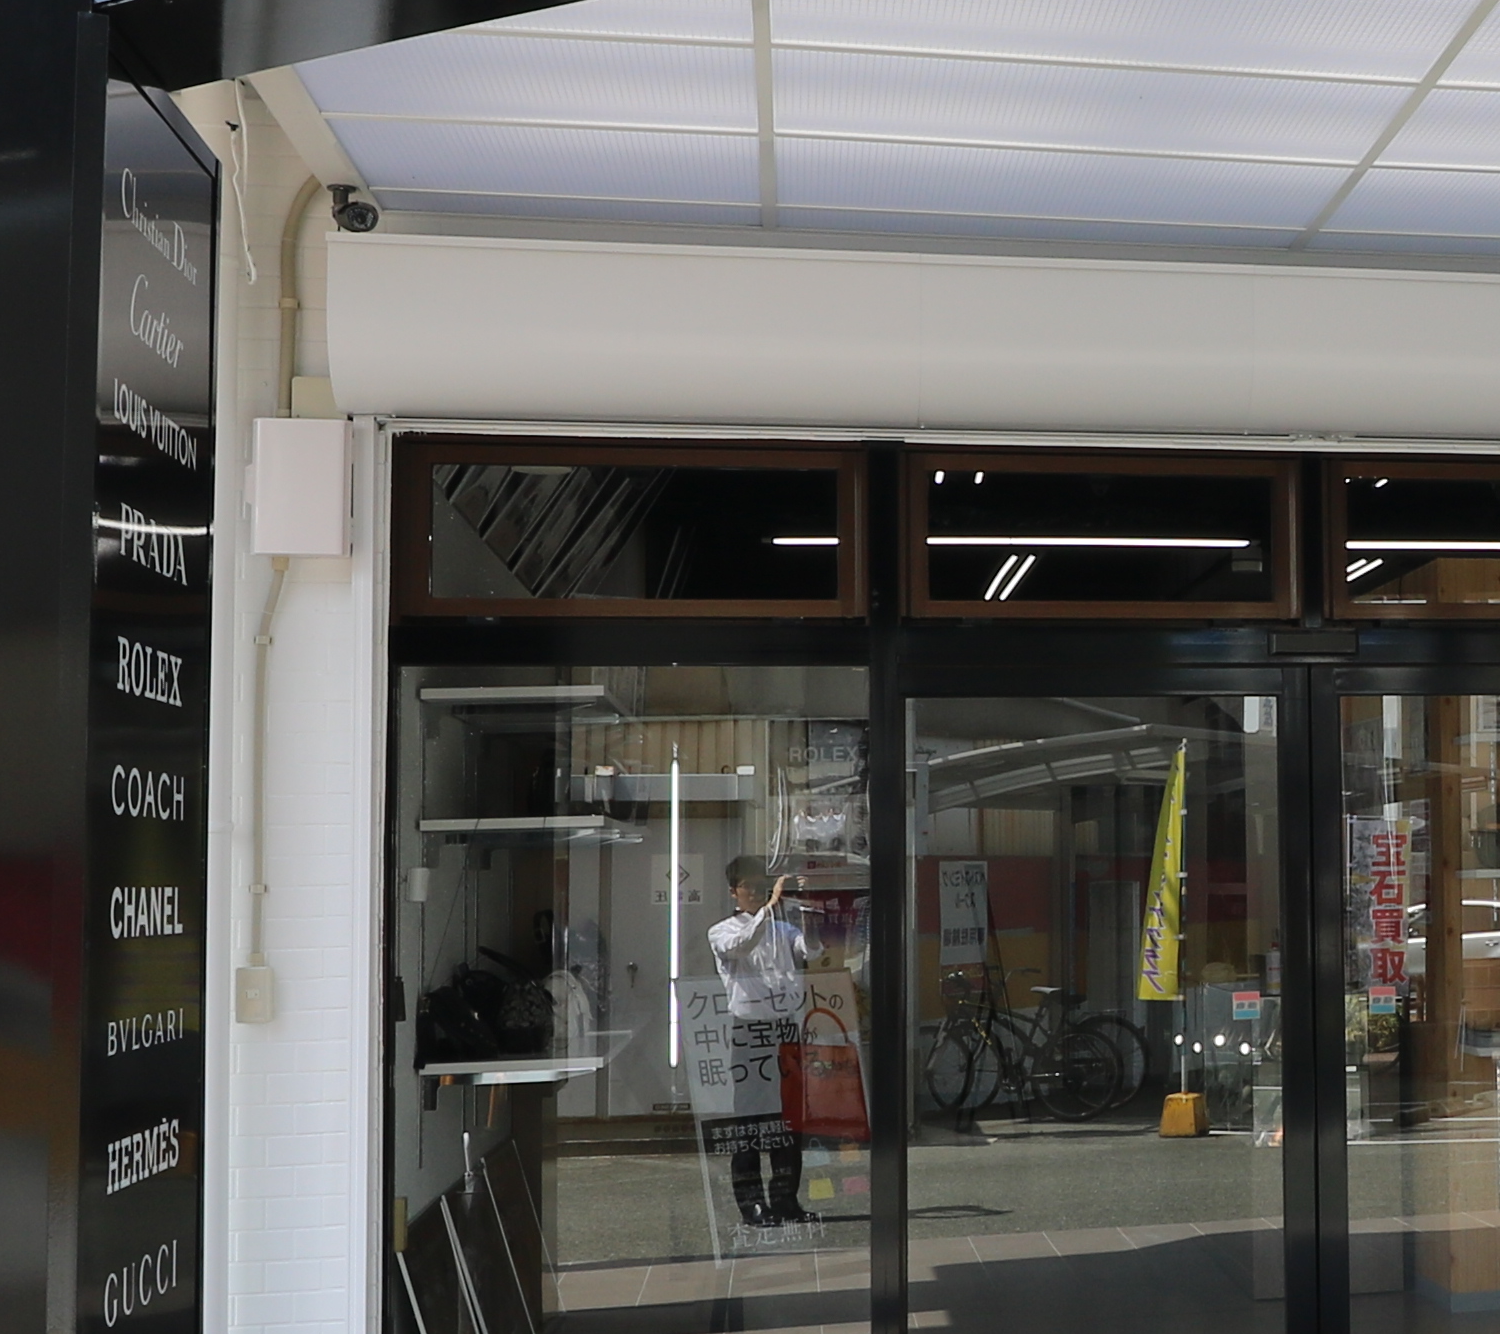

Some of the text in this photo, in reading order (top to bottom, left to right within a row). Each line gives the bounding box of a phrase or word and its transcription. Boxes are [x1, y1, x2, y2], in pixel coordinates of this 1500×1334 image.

[121, 168, 198, 286] Christian Dior
[130, 274, 184, 368] Cartier
[114, 378, 197, 471] LOUIS VUITTON
[119, 503, 189, 588] PRADA
[116, 637, 183, 708] ROLEX
[110, 764, 185, 822] COACH
[109, 886, 183, 940] CHANEL
[1369, 833, 1409, 985] 宝石買取
[107, 1008, 184, 1057] BVLGARI
[687, 983, 844, 1020] クローゼットの
[694, 1018, 819, 1055] 中に宝物が
[106, 1119, 180, 1195] HERMÈS
[711, 1119, 793, 1141] まずはお気軽に
[713, 1135, 795, 1155] お持ちください
[105, 1240, 177, 1328] GUCCI
